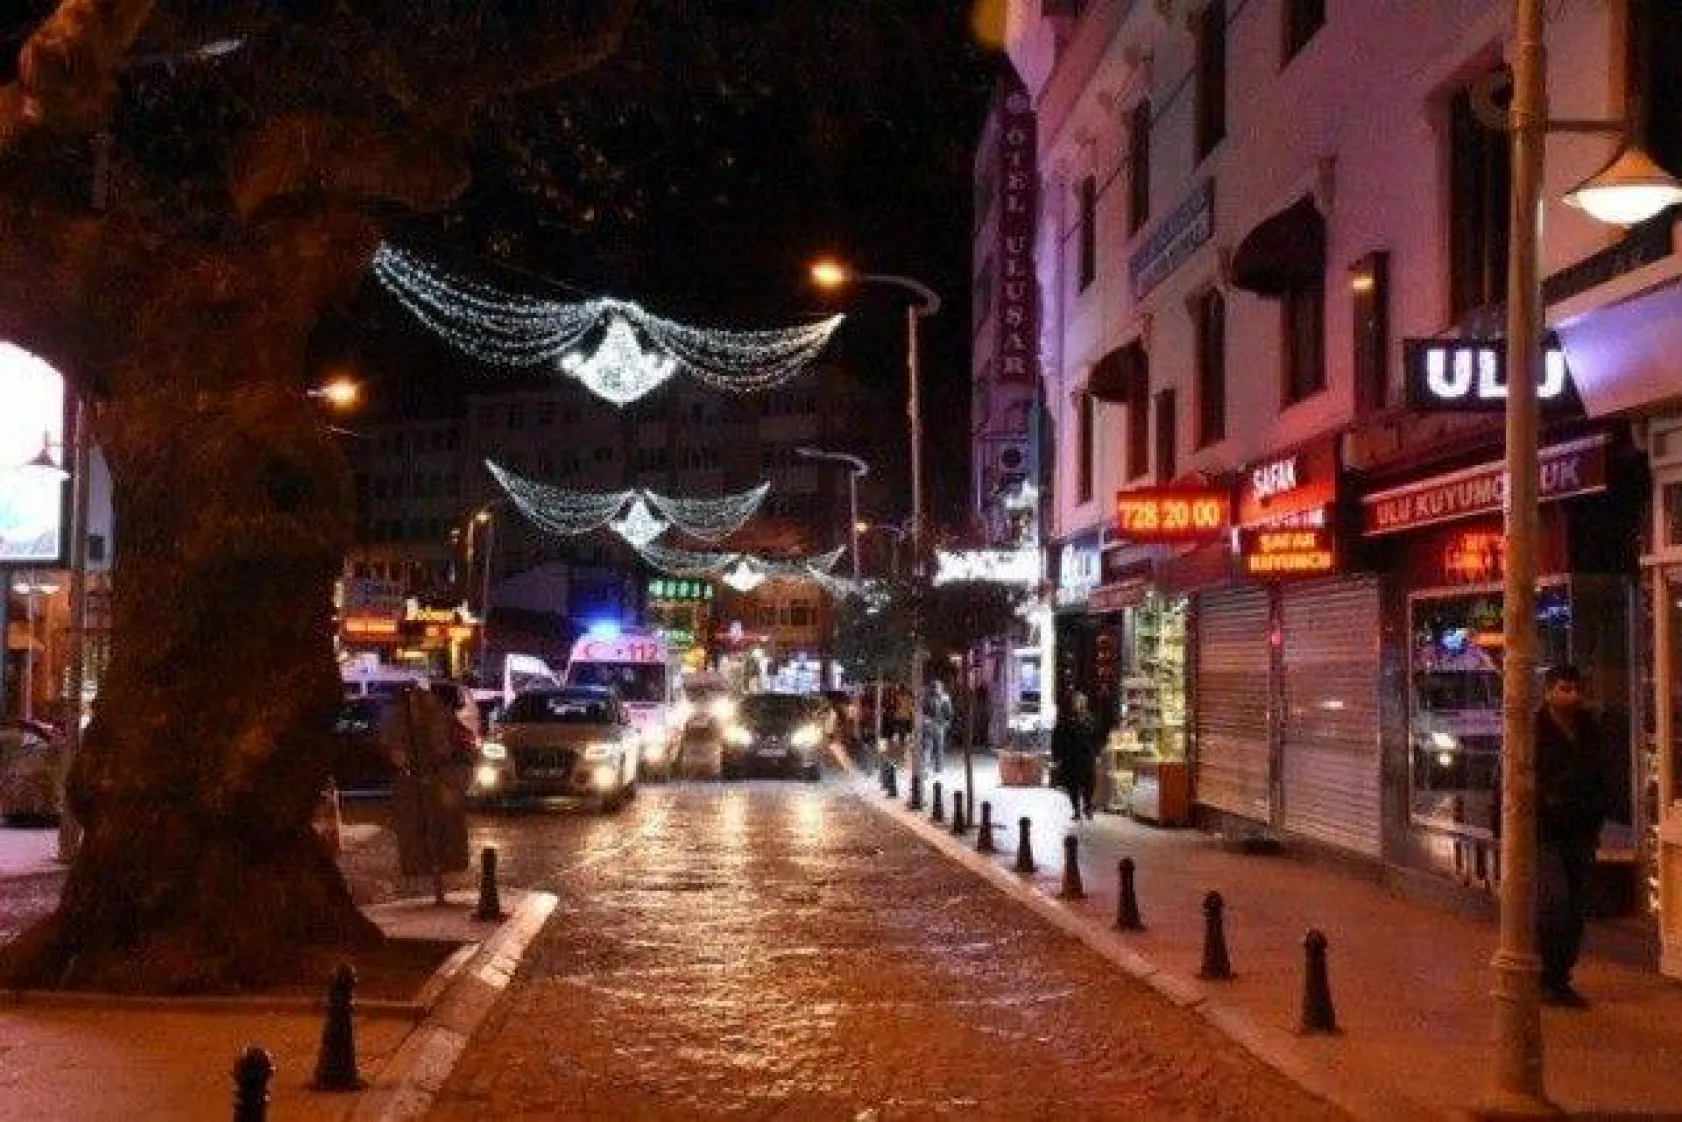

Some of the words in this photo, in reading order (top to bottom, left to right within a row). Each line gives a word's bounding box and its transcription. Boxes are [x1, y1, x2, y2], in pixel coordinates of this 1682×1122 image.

[1427, 348, 1565, 398] ULU
[1118, 500, 1159, 530] 728
[1162, 499, 1189, 529] 20
[1192, 499, 1220, 528] 00
[628, 642, 659, 661] 112
